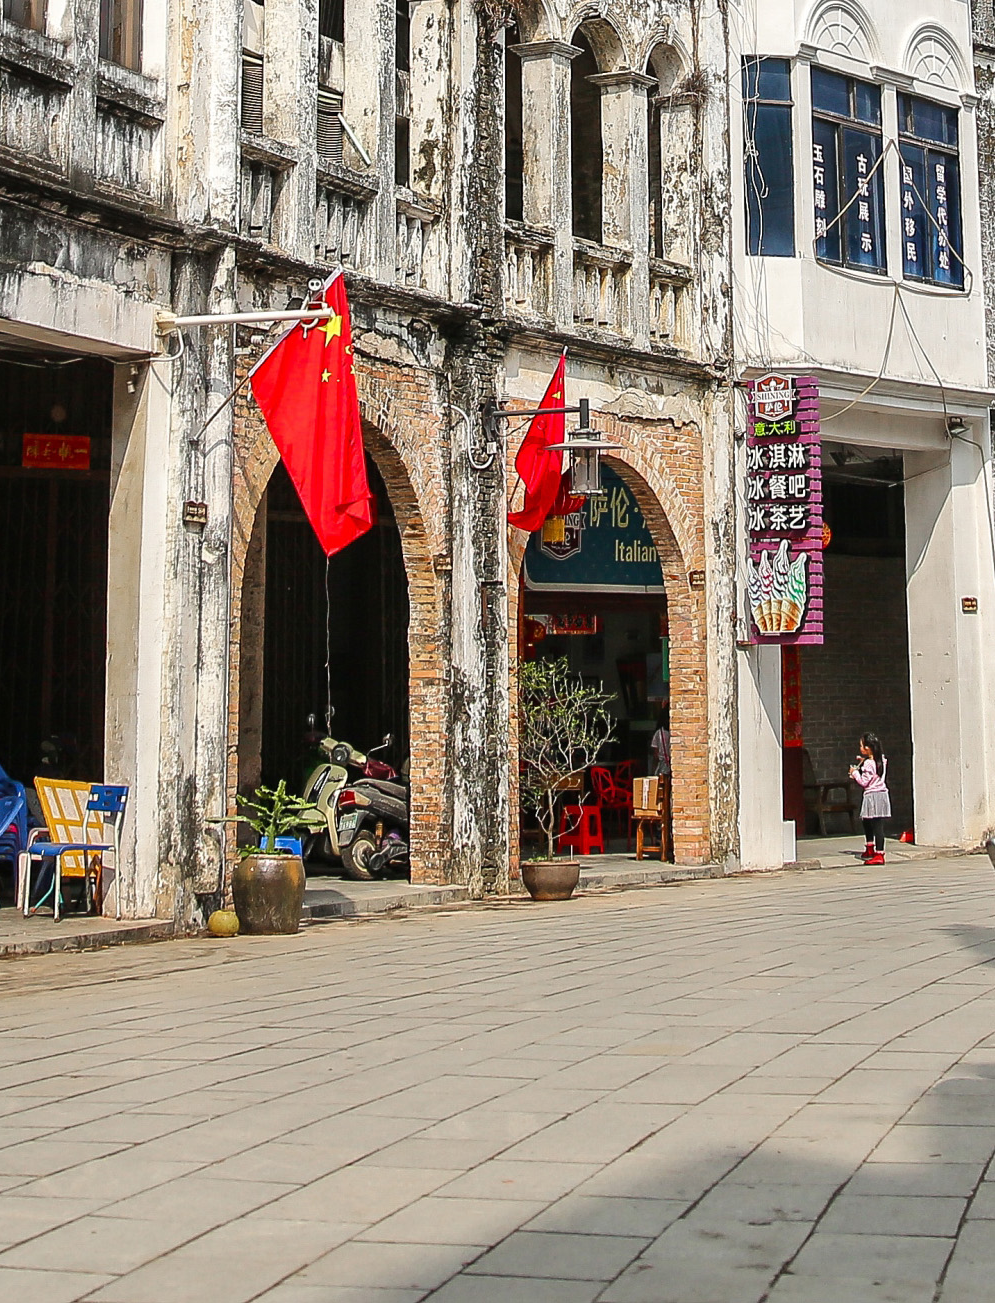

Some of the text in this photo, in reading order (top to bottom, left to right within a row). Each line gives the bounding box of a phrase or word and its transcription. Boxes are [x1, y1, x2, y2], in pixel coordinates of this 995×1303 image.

[813, 143, 826, 238] 玉石雕刻
[856, 153, 872, 253] 古玩展示
[902, 165, 917, 262] 国外移民
[935, 163, 950, 270] 留学代办处
[756, 391, 790, 401] SHINING
[754, 420, 796, 437] 意大利
[747, 443, 806, 470] 冰淇淋
[747, 474, 806, 500] 冰餐吧
[748, 504, 806, 532] 冰茶艺
[615, 539, 657, 562] Italian
